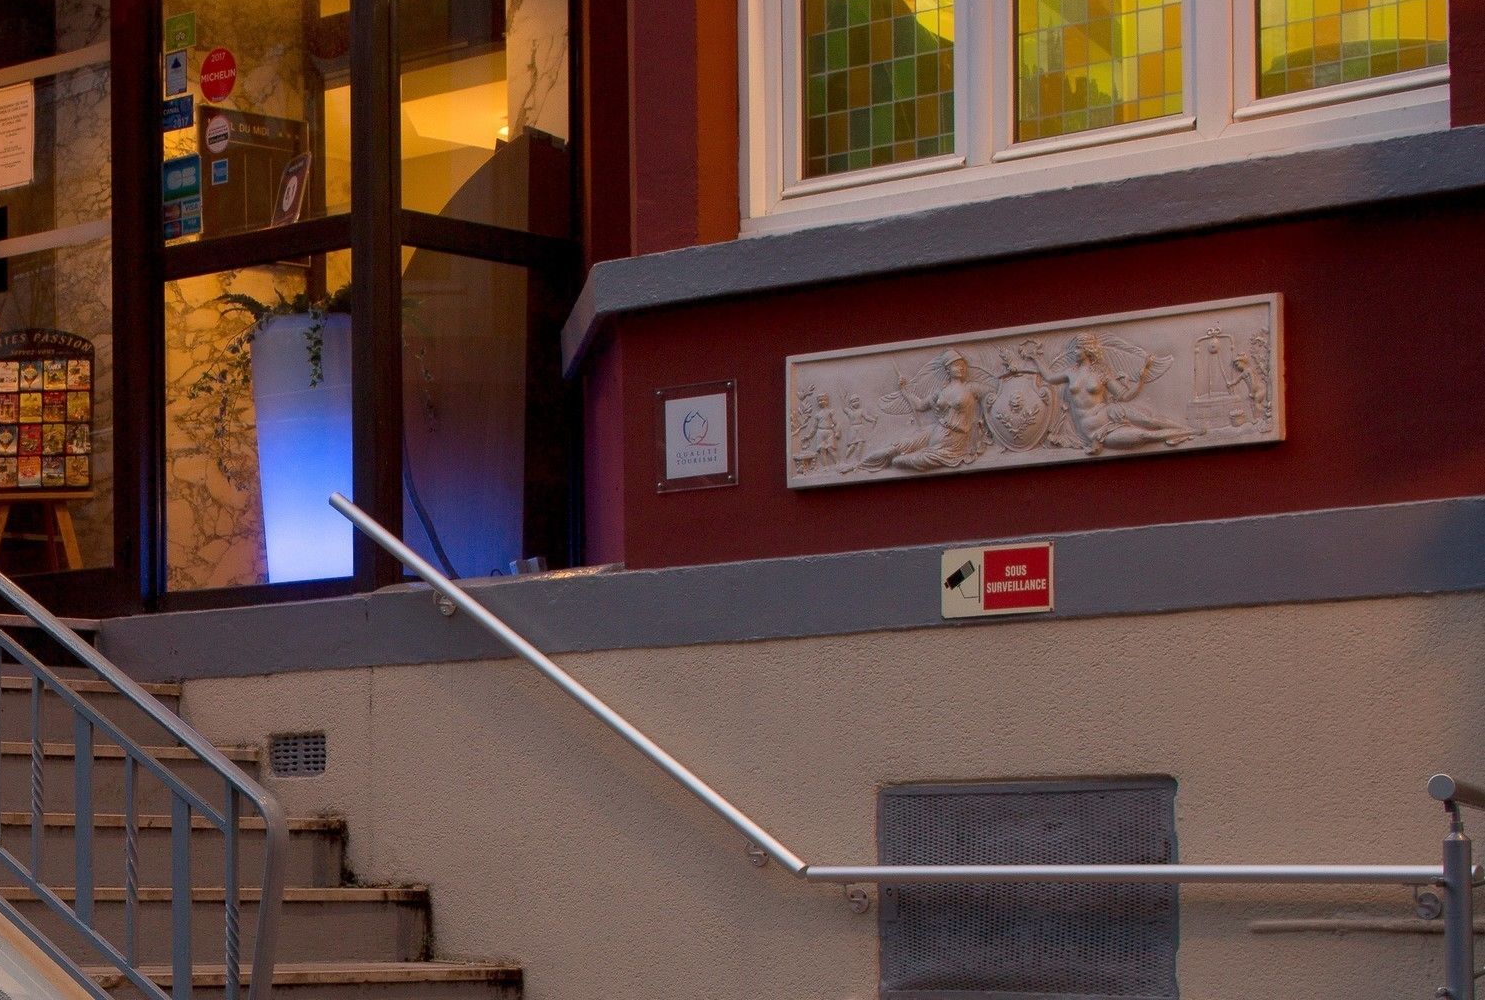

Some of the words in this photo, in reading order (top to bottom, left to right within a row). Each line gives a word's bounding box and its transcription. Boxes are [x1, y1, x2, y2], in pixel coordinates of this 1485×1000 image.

[211, 52, 226, 63] 2017
[201, 68, 236, 83] MICHELIN
[33, 333, 92, 352] PASSION
[676, 456, 717, 465] TOURISME
[1005, 564, 1027, 577] SOUS
[986, 578, 1047, 594] SURVEILLANCE
